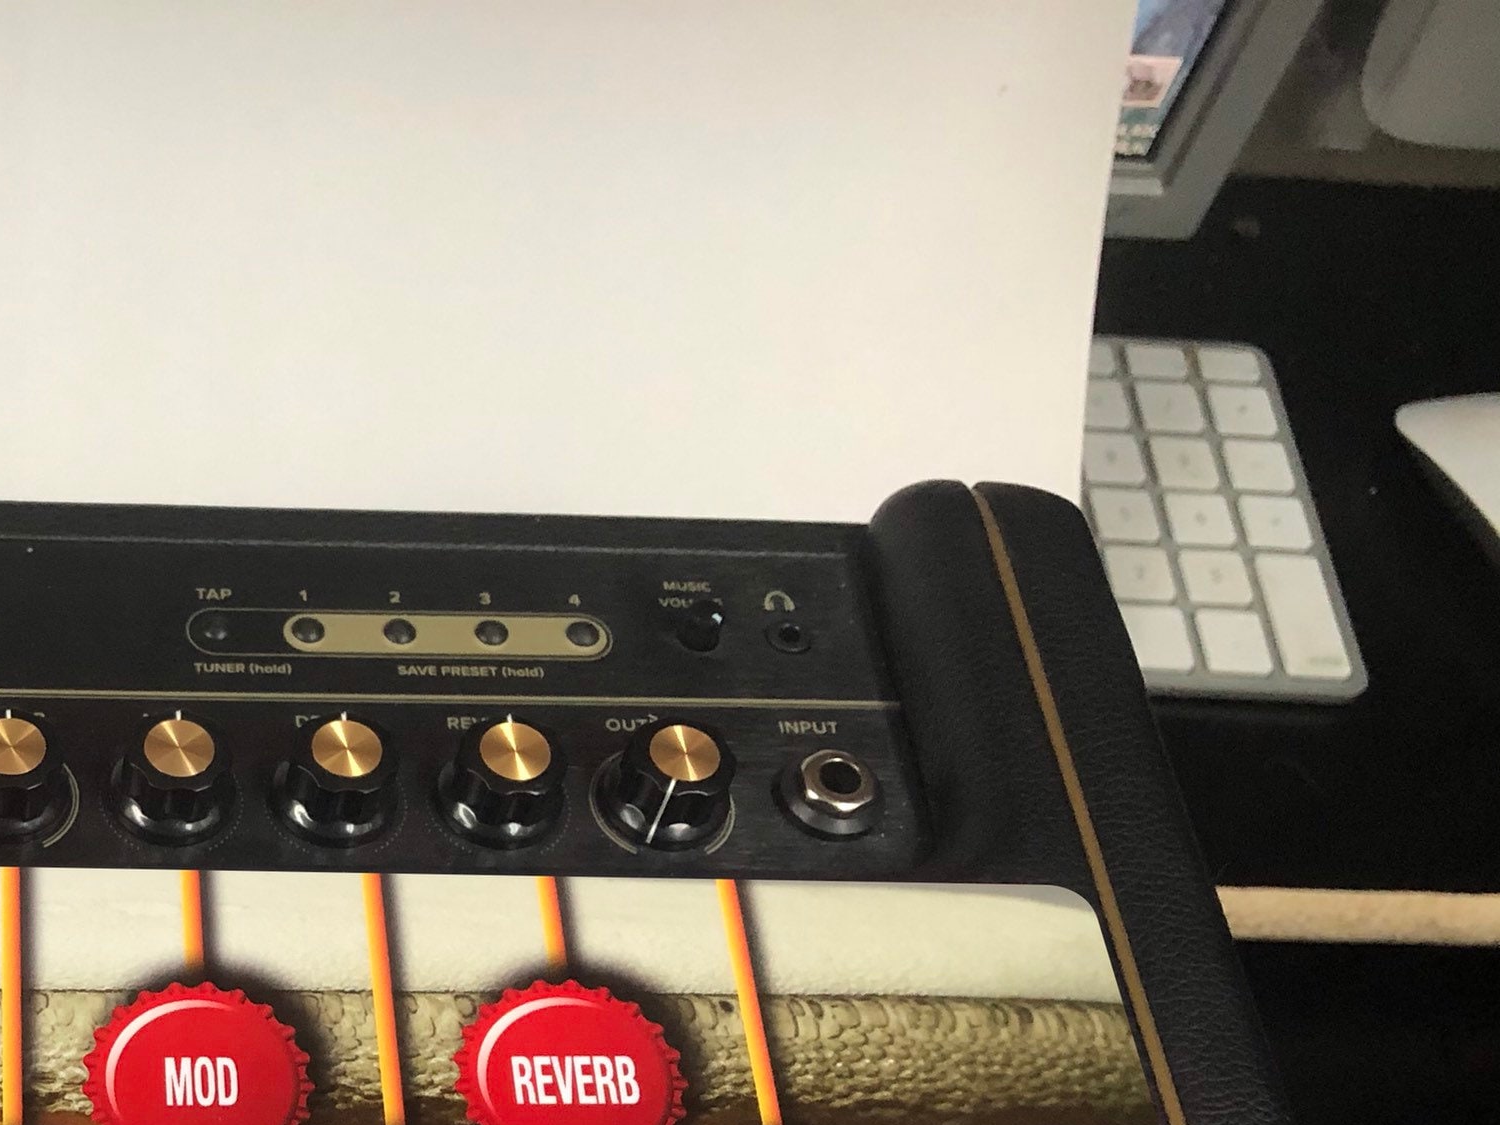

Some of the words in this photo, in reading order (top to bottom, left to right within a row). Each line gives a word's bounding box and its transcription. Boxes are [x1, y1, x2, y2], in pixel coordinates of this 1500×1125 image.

[195, 587, 233, 601] TAP
[662, 580, 712, 593] MUSIC
[299, 589, 309, 602] 1
[388, 590, 401, 604] 2
[478, 591, 492, 606] 3
[567, 593, 582, 608] 4
[193, 661, 246, 675] TUNER
[249, 662, 293, 676] (hold)
[397, 664, 438, 677] SAVE
[440, 665, 498, 678] PRESET
[501, 666, 546, 680] (hold)
[778, 720, 838, 735] INPUT
[164, 1056, 240, 1107] MOD
[511, 1054, 641, 1106] REVERB
